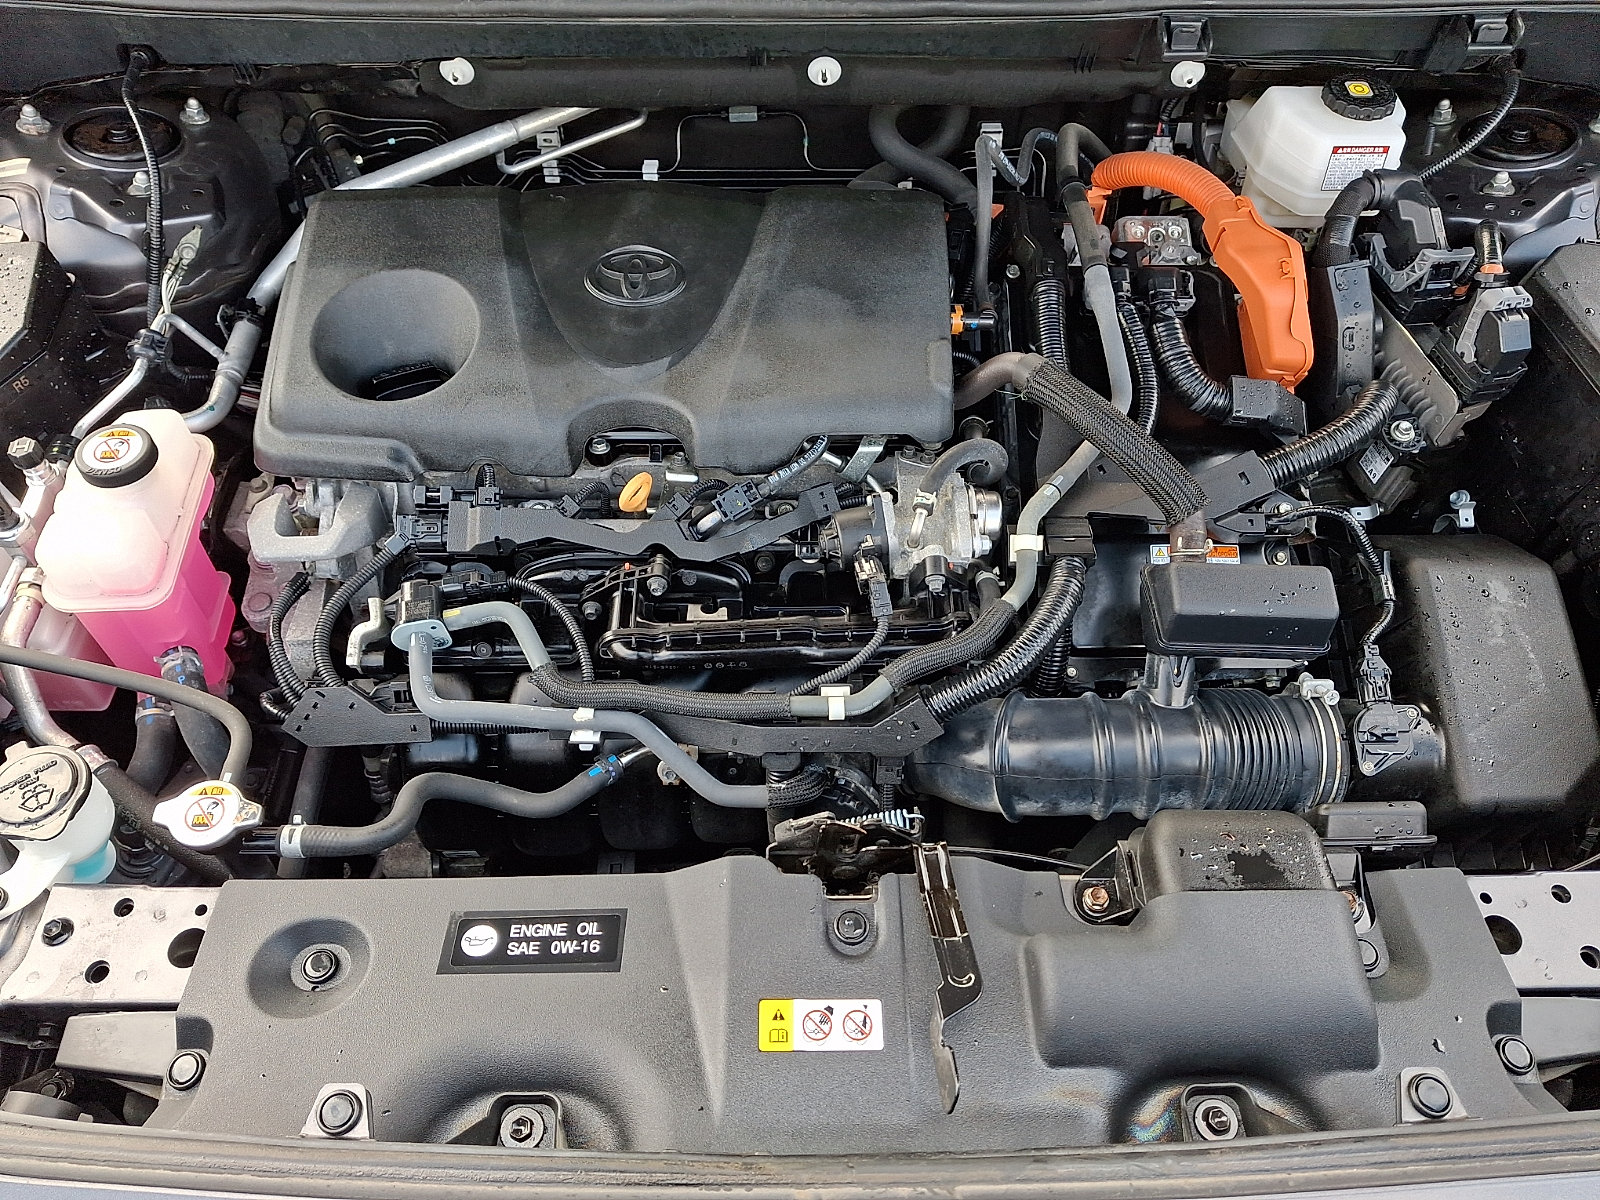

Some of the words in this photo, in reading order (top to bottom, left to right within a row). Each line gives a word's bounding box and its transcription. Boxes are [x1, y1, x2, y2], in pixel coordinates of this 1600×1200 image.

[12, 440, 32, 453] H
[86, 466, 122, 476] DENSO
[509, 923, 568, 938] ENGINE
[577, 922, 602, 936] OIL
[506, 942, 540, 956] SAE
[551, 940, 600, 955] 0W-16
